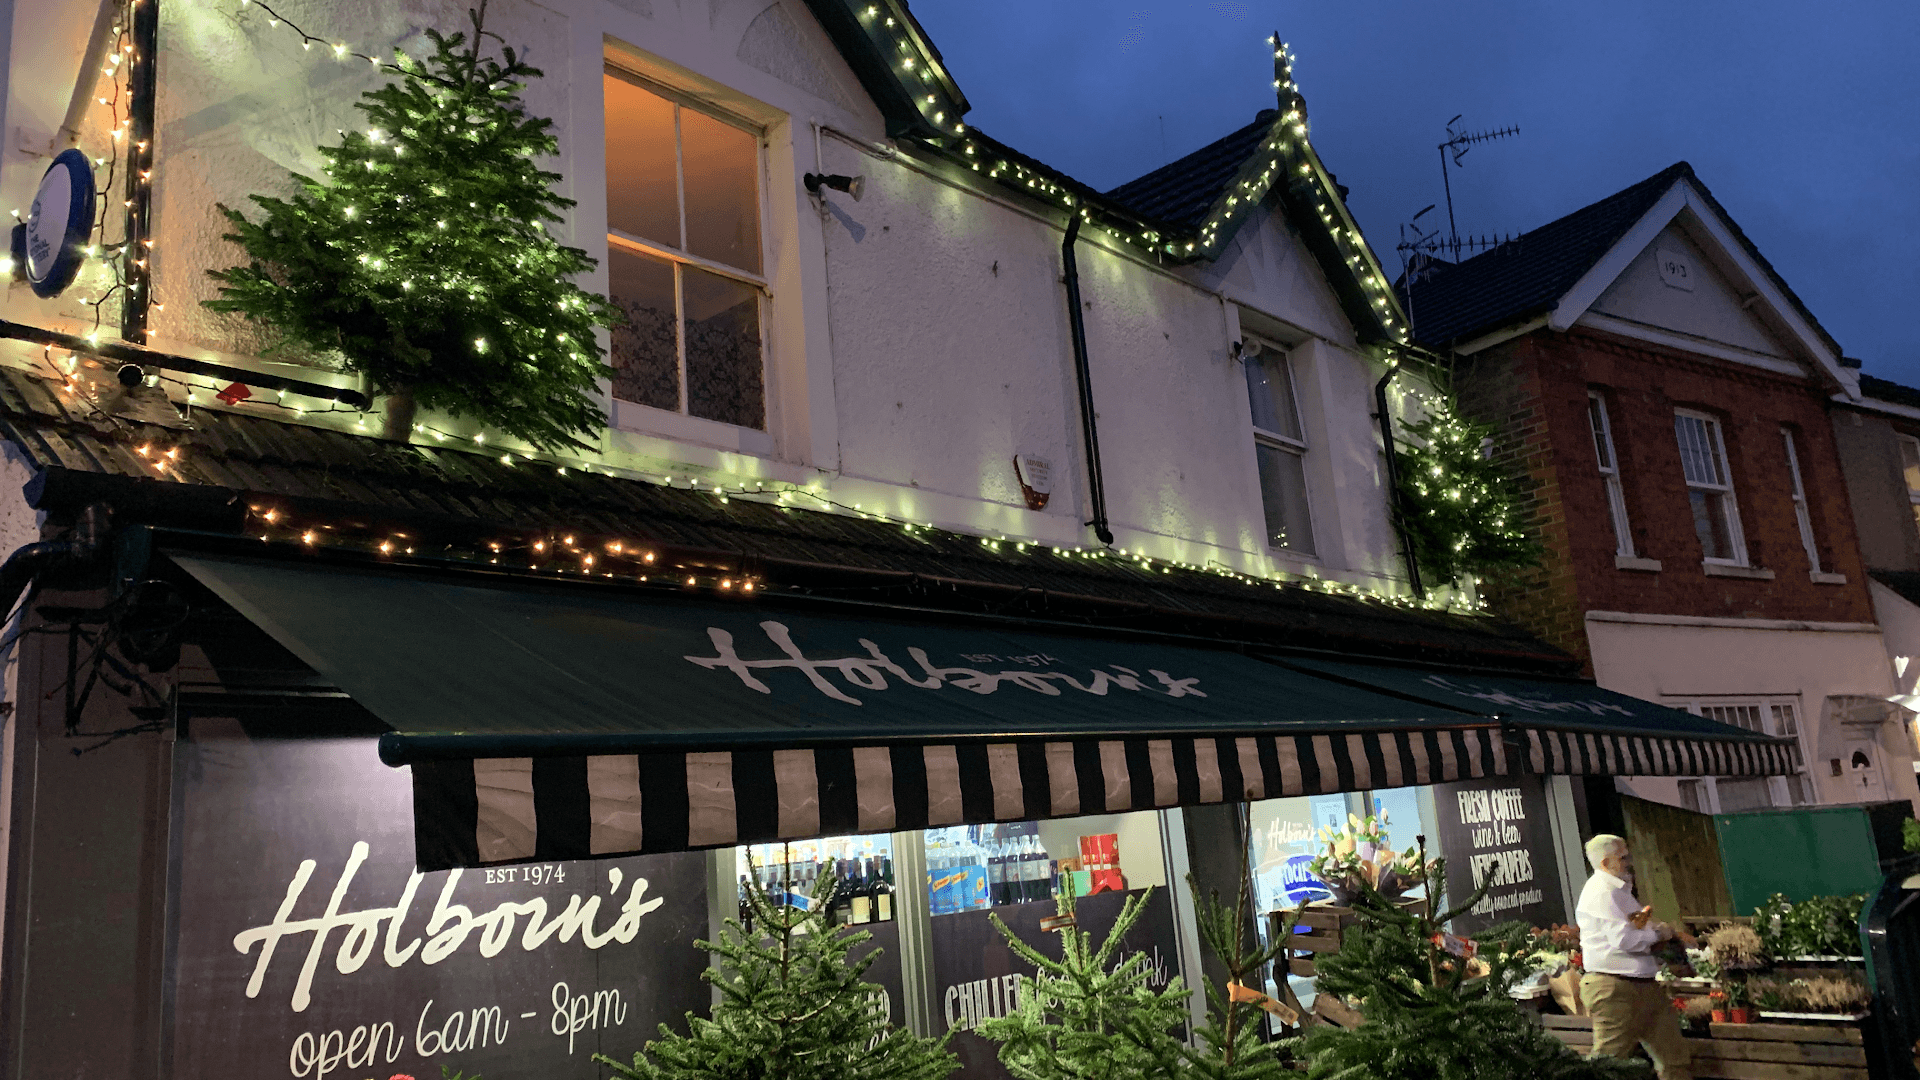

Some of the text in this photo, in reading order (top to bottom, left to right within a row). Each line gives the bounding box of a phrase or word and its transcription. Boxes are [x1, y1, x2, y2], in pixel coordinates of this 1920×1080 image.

[683, 619, 1208, 706] Holborn's
[1457, 788, 1526, 824] FRESH COFFEE
[1472, 820, 1522, 849] wine & beer
[485, 864, 566, 886] EST 1974
[1470, 849, 1534, 891] NEWSPAPERS
[234, 840, 664, 1013] Holborn's
[289, 1019, 406, 1080] open
[415, 999, 509, 1058] 6am
[551, 981, 627, 1055] 8pm
